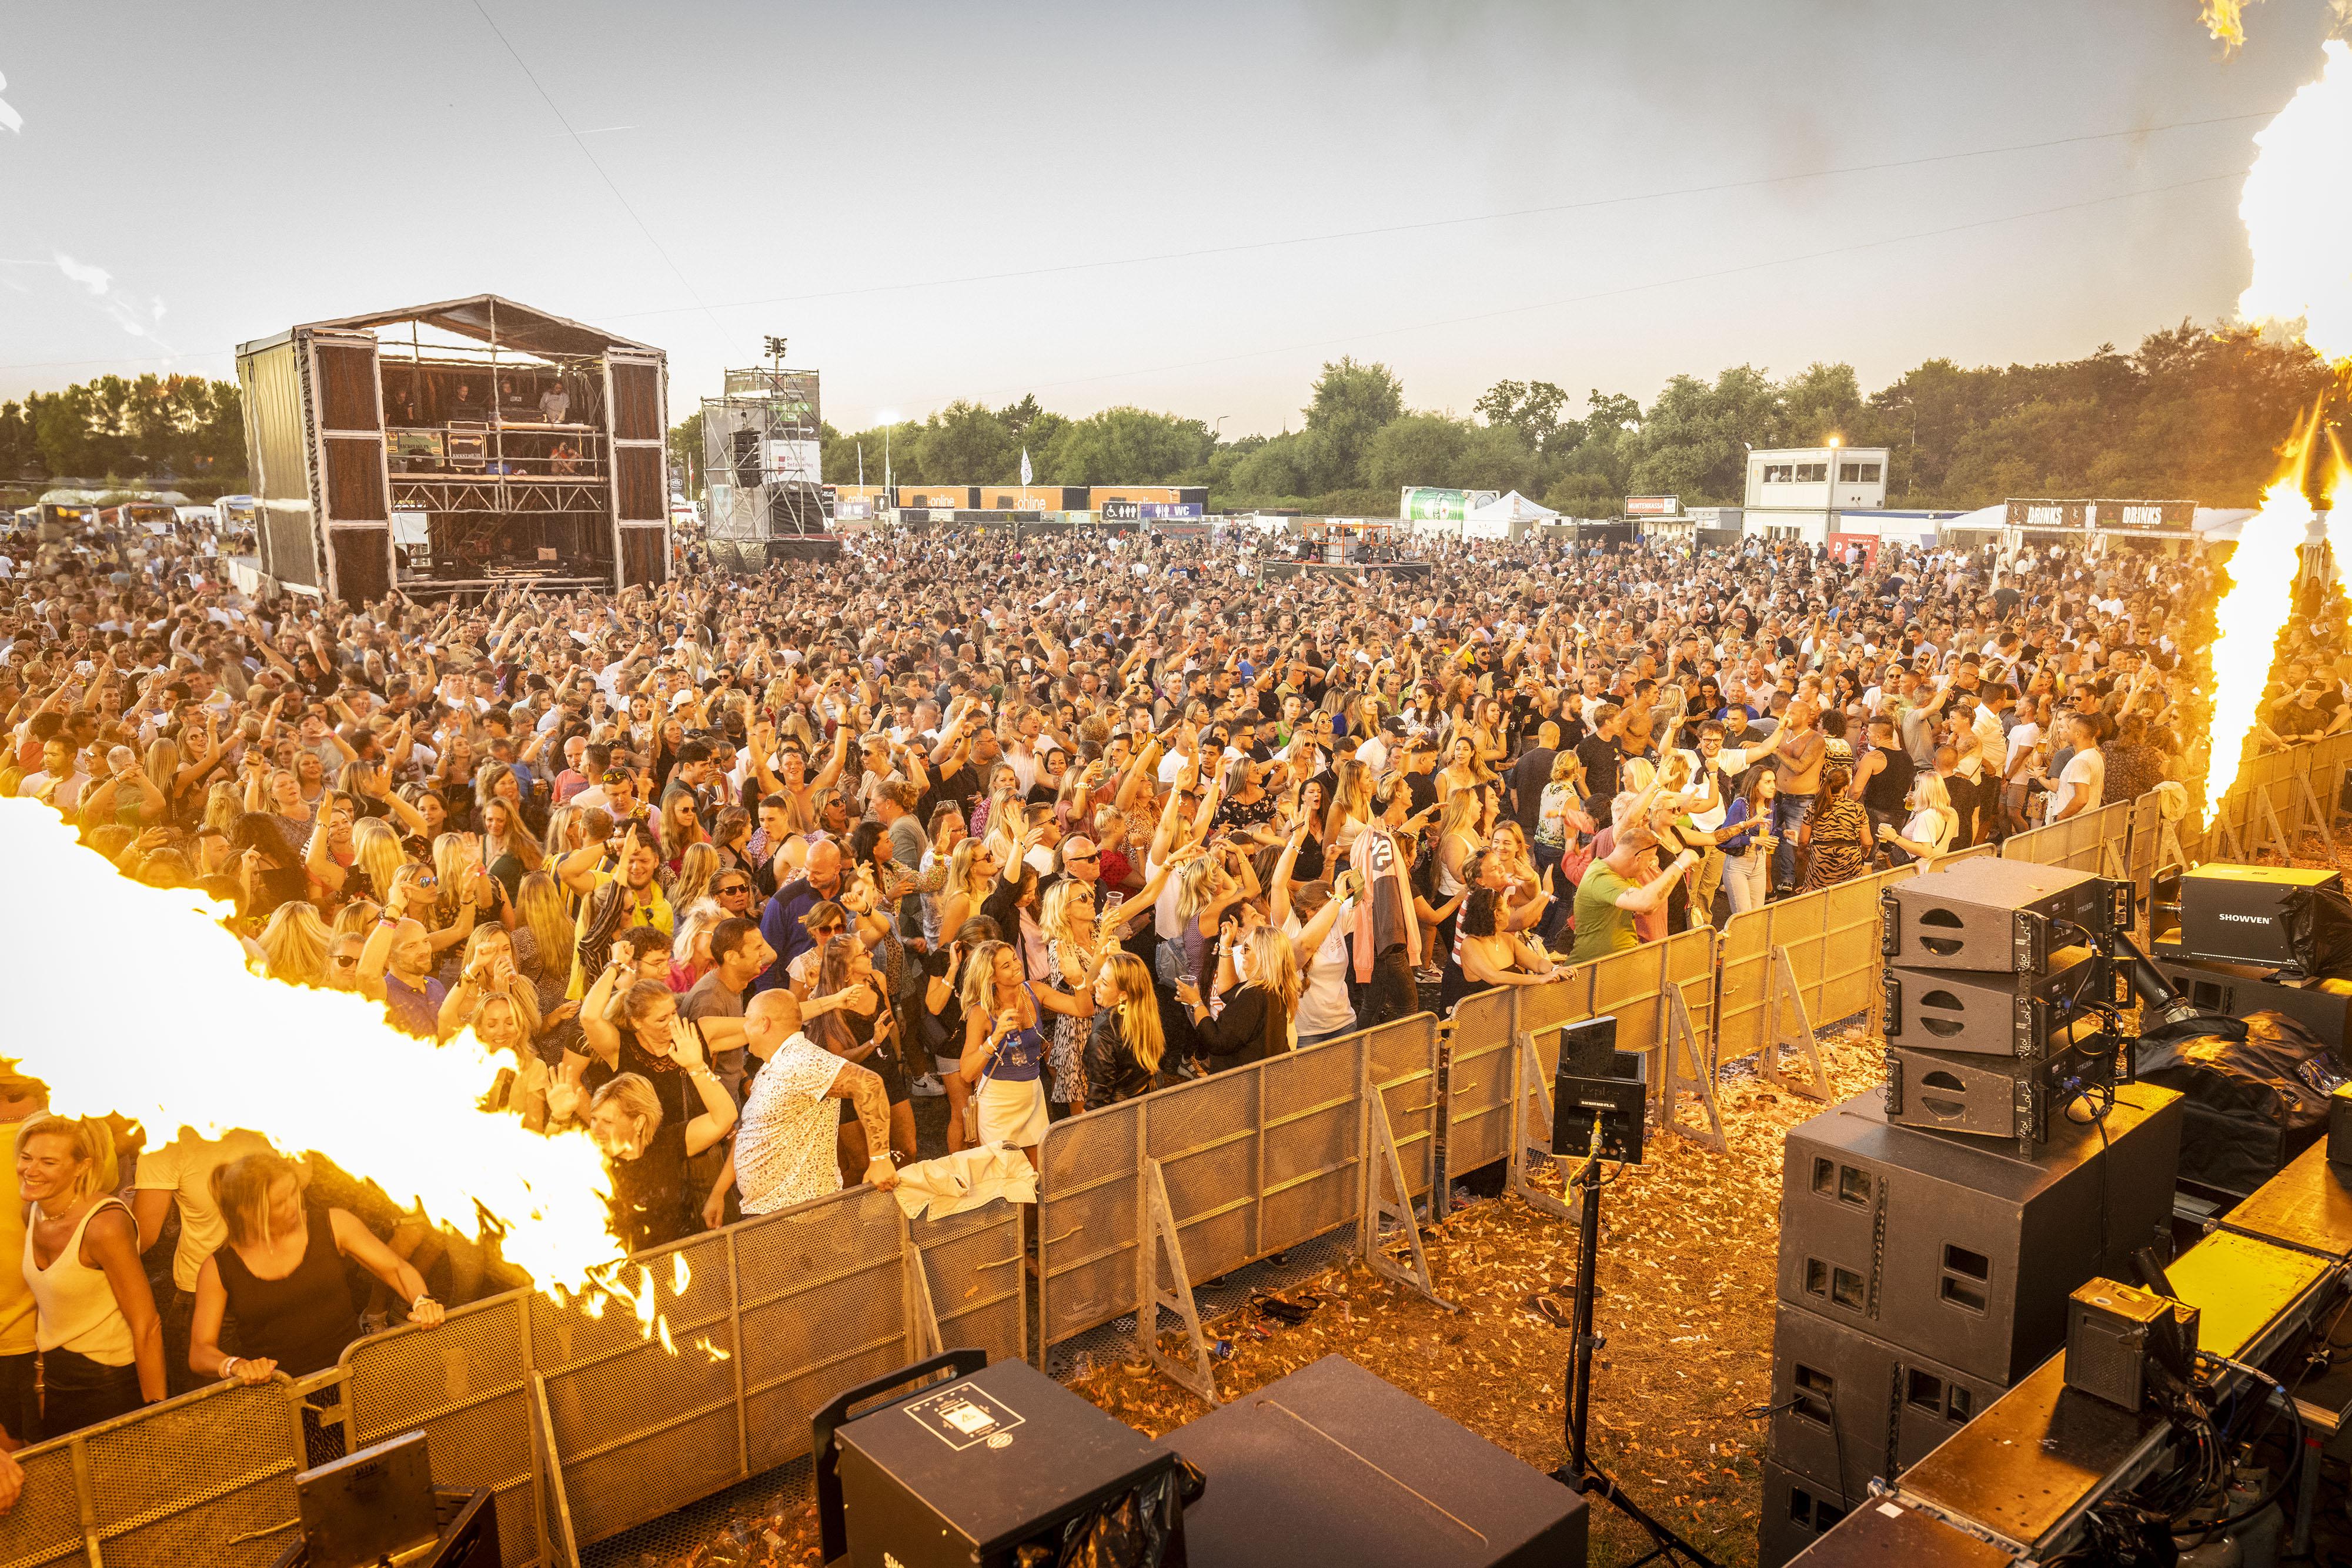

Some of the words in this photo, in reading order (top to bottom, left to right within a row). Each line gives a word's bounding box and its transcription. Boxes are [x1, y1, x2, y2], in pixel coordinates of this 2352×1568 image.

[927, 493, 955, 507] -online
[853, 504, 864, 515] WC
[1174, 506, 1190, 516] WC
[2027, 506, 2063, 525] DRINKS
[2122, 506, 2162, 525] DRINKS
[2219, 914, 2270, 925] SHOWVEN
